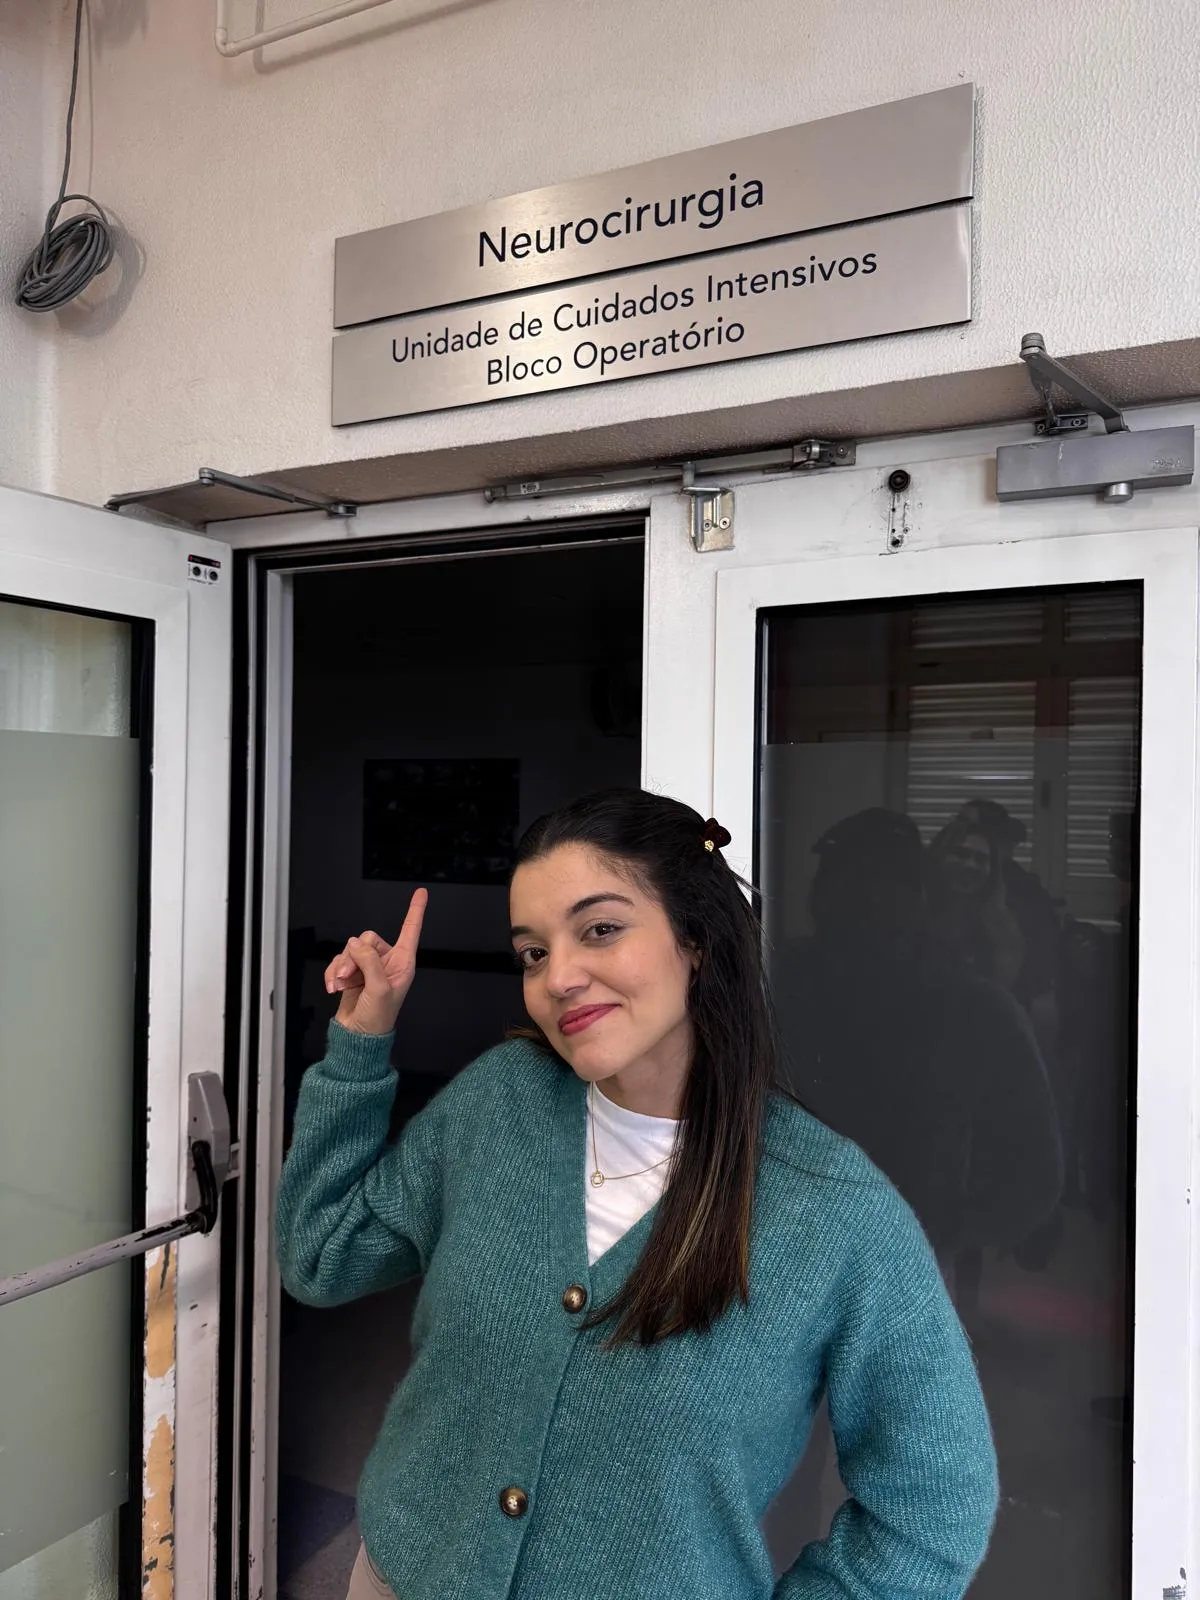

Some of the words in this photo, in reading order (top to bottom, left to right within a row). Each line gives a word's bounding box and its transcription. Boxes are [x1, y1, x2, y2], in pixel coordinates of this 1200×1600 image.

[479, 172, 764, 267] Neurocirurgia
[392, 320, 499, 363] Unidade
[509, 311, 543, 341] de
[553, 284, 694, 332] Cuidados
[707, 253, 877, 303] Intensivos
[487, 355, 562, 385] Bloco
[573, 316, 745, 376] Operatório
